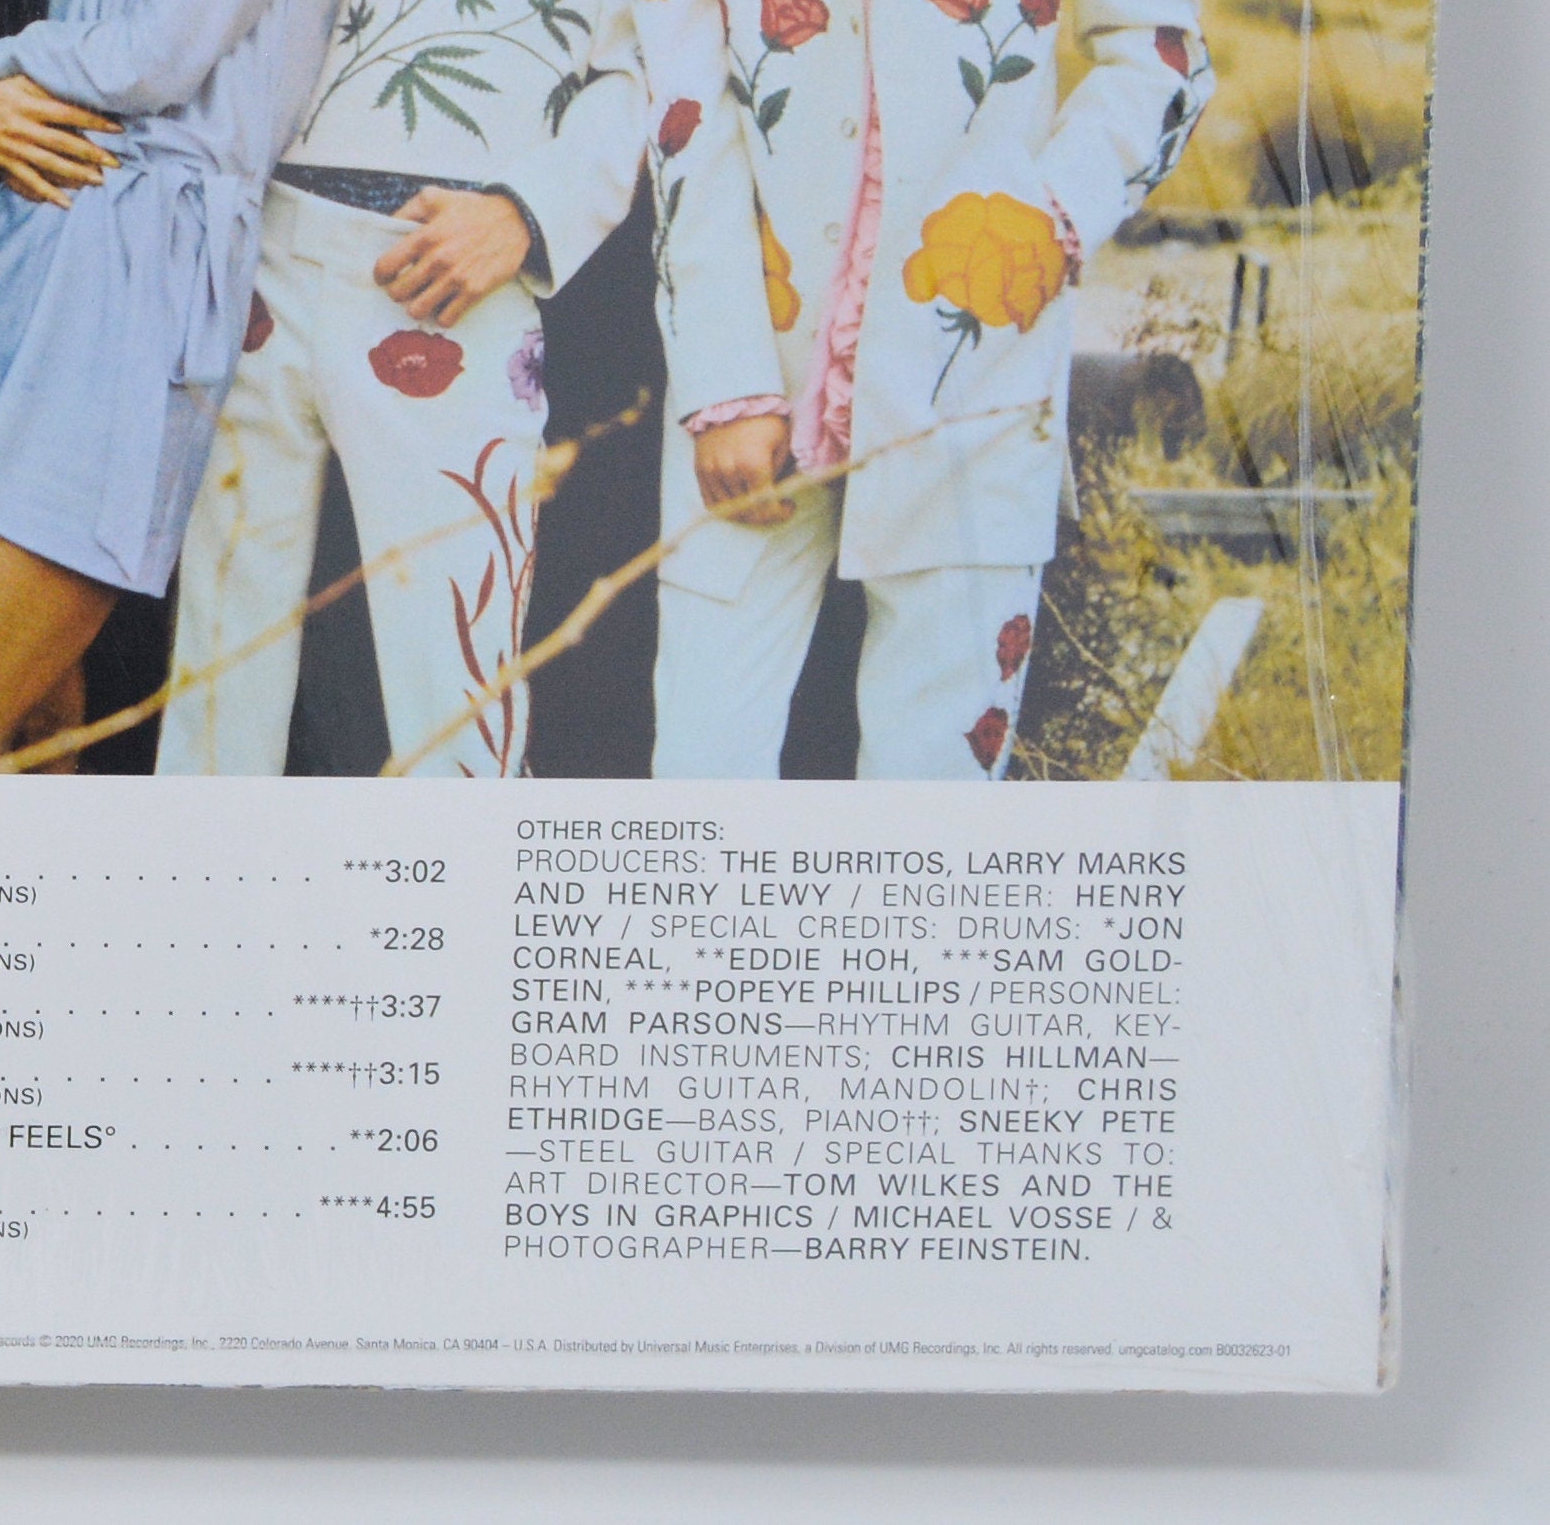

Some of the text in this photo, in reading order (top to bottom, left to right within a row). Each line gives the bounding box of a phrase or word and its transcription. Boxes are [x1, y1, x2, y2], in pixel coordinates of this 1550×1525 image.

[516, 819, 724, 841] OTHER CREDITS:
[516, 848, 1186, 878] PRODUCERS: THE BURRITOS, LARRY MARKS
[513, 881, 585, 905] AND
[608, 881, 719, 906] HENRY
[741, 882, 832, 907] LEWY
[882, 883, 1052, 908] ENGINEER:
[1076, 884, 1186, 908] HENRY
[505, 1202, 590, 1227] BOYS
[607, 1203, 637, 1227] IN
[654, 1203, 813, 1229] GRAPHICS
[853, 1205, 993, 1229] MICHAEL
[1008, 1205, 1112, 1230] VOSSE
[1152, 1206, 1172, 1230] &
